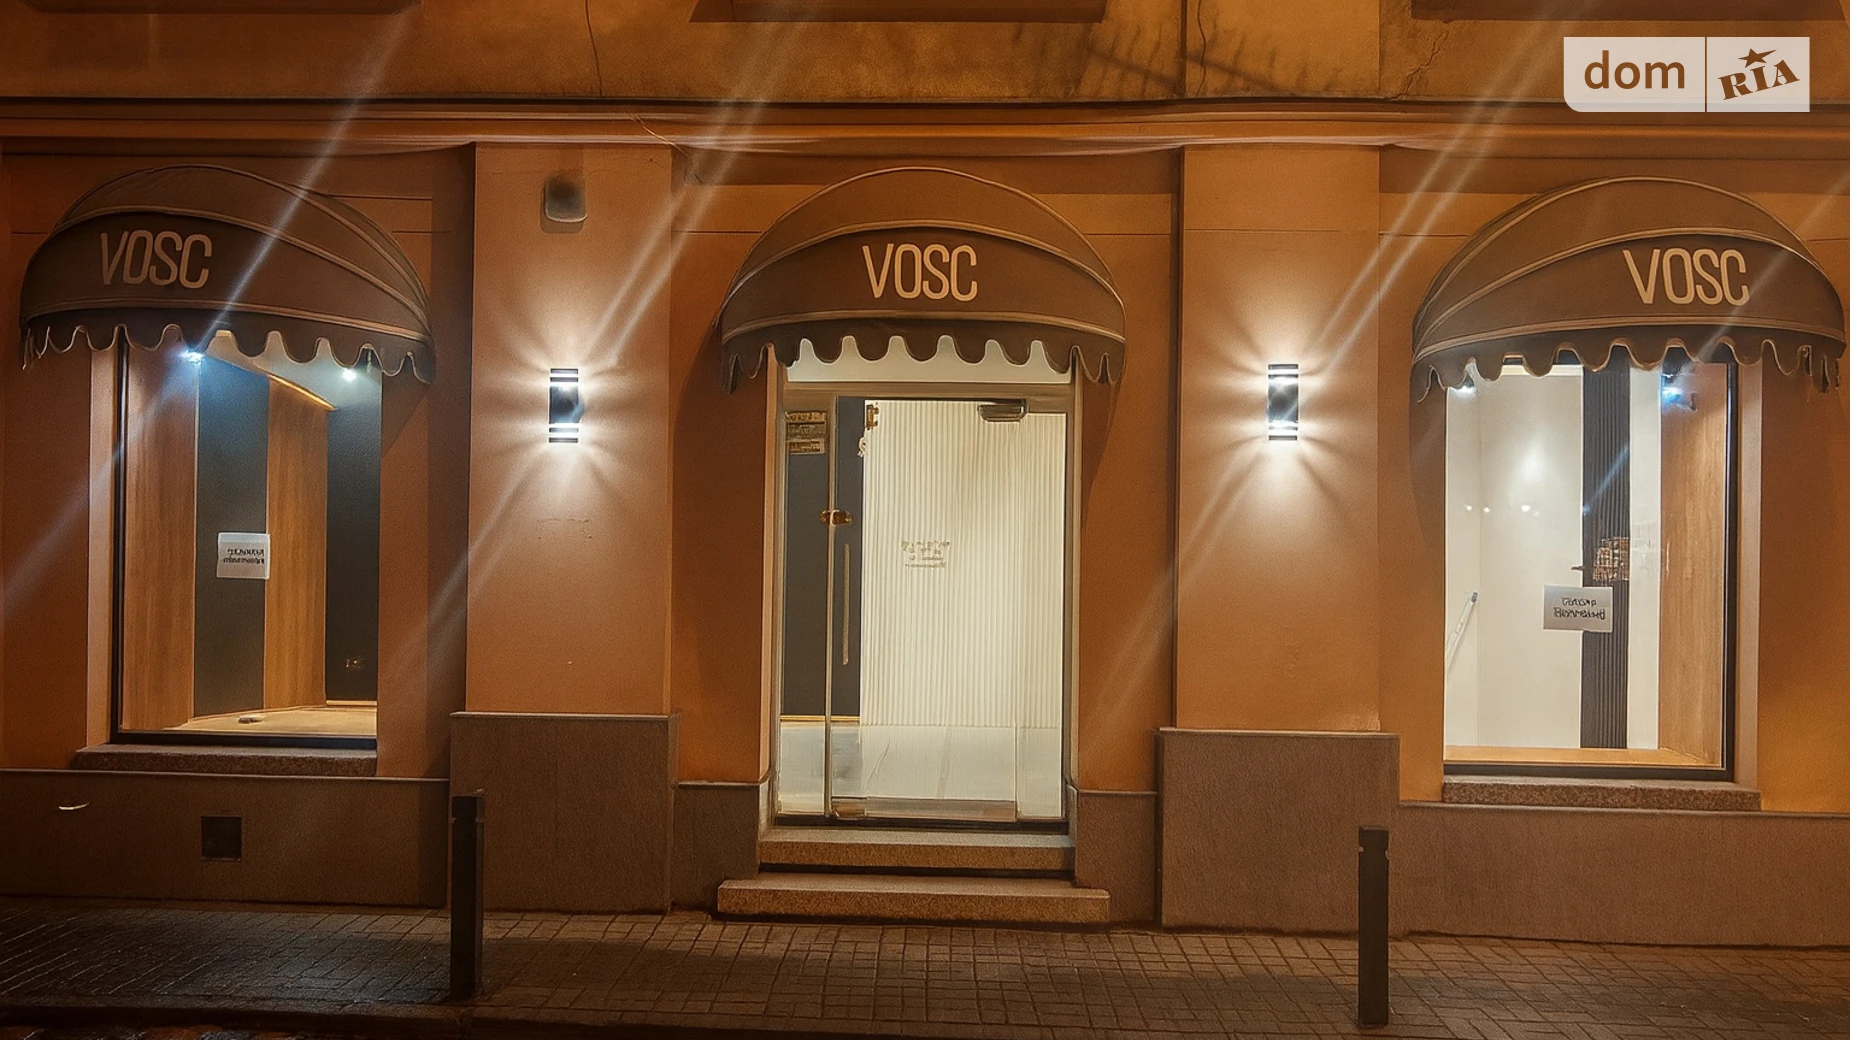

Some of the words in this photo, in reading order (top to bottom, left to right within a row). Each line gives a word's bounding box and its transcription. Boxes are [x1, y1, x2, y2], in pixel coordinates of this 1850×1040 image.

[100, 229, 212, 289] VOSC
[862, 243, 978, 301] VOSC
[1622, 247, 1750, 306] VOSC
